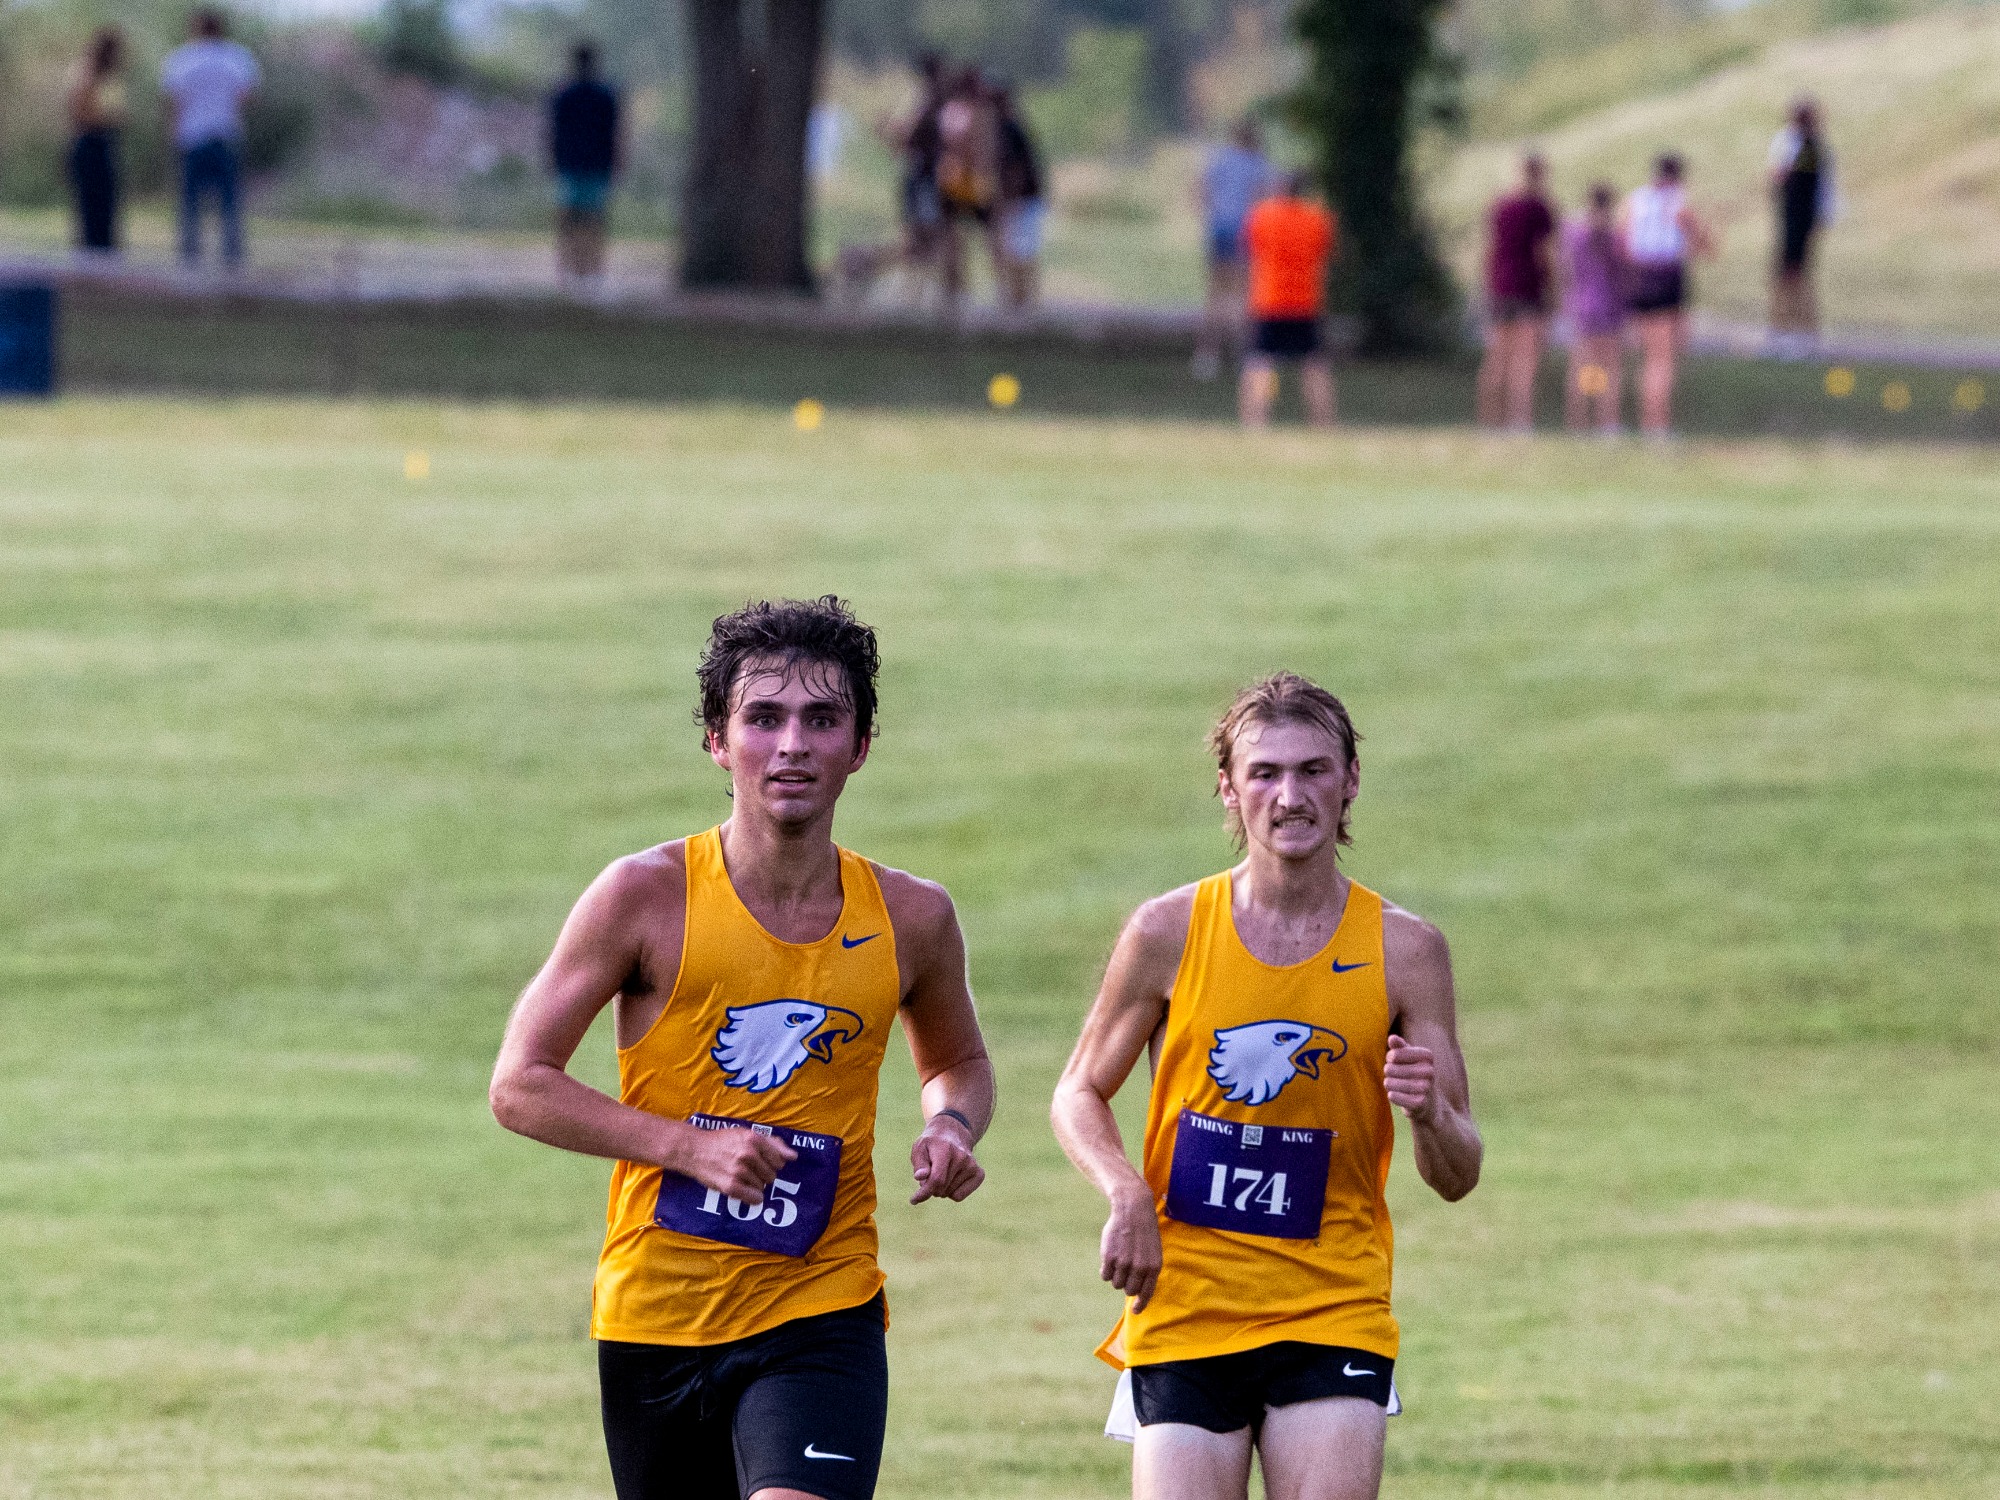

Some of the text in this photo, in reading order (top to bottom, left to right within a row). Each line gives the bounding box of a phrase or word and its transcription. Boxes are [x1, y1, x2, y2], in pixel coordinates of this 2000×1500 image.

[792, 1134, 825, 1150] KING
[1190, 1115, 1313, 1143] TIMING KING
[1203, 1163, 1291, 1216] 174
